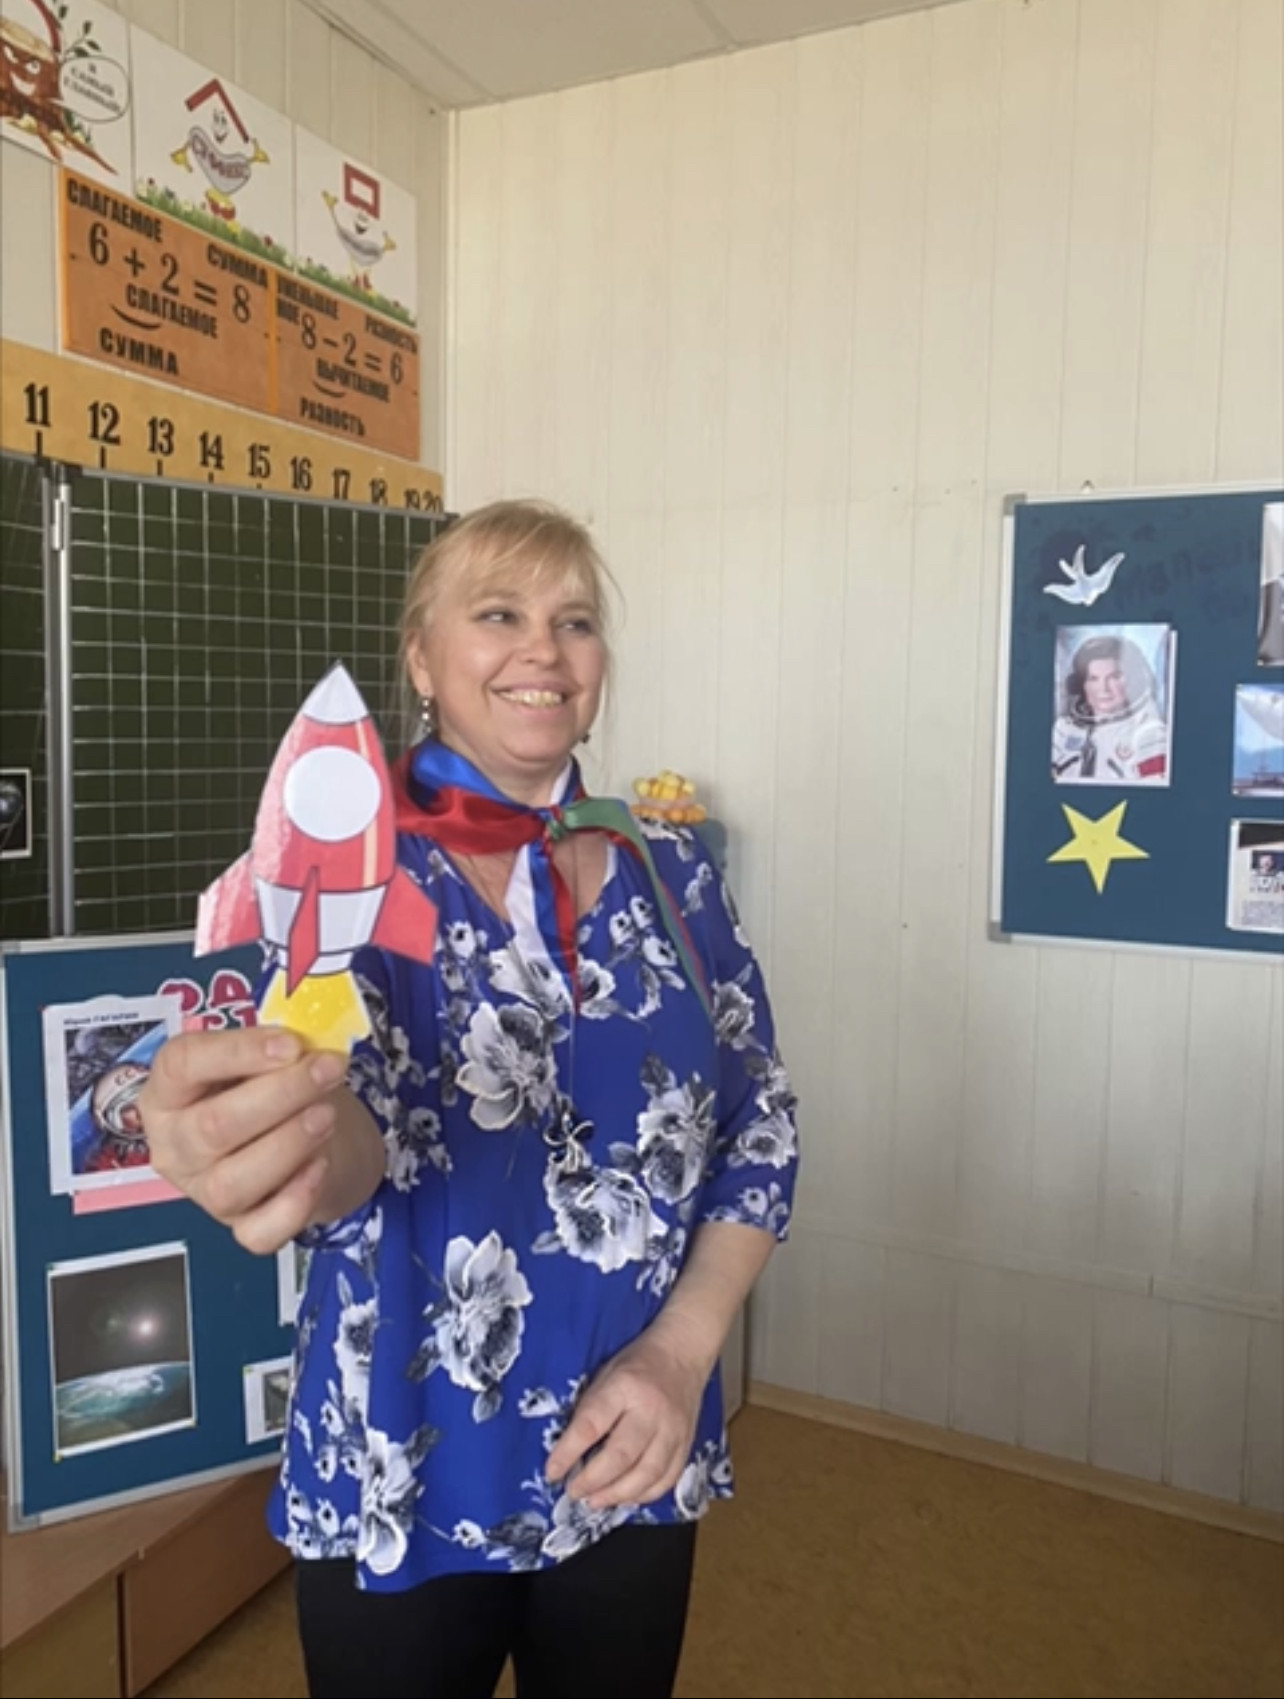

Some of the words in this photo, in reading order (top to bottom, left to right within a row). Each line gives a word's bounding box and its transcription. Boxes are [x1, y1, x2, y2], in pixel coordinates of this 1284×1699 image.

[67, 178, 162, 242] СЛАГАЕМОЕ
[89, 222, 109, 265] 6
[124, 248, 145, 277] +
[161, 253, 179, 295] 2
[194, 280, 217, 306] =
[233, 285, 250, 323] 8
[207, 242, 268, 289] СУММА
[126, 283, 217, 339] СЛАГАЕМОЕ
[100, 328, 179, 375] СУММА
[302, 312, 316, 350] 8
[344, 333, 356, 366] 2
[391, 352, 404, 384] 6
[24, 382, 51, 427] 11
[88, 401, 121, 446] 12
[148, 416, 174, 457] 13
[199, 431, 224, 470] 14
[248, 443, 271, 479] 15
[290, 456, 313, 491] 16
[333, 468, 350, 500] 17
[370, 478, 388, 506] 18
[301, 397, 365, 436] РАЗНОСТЬ
